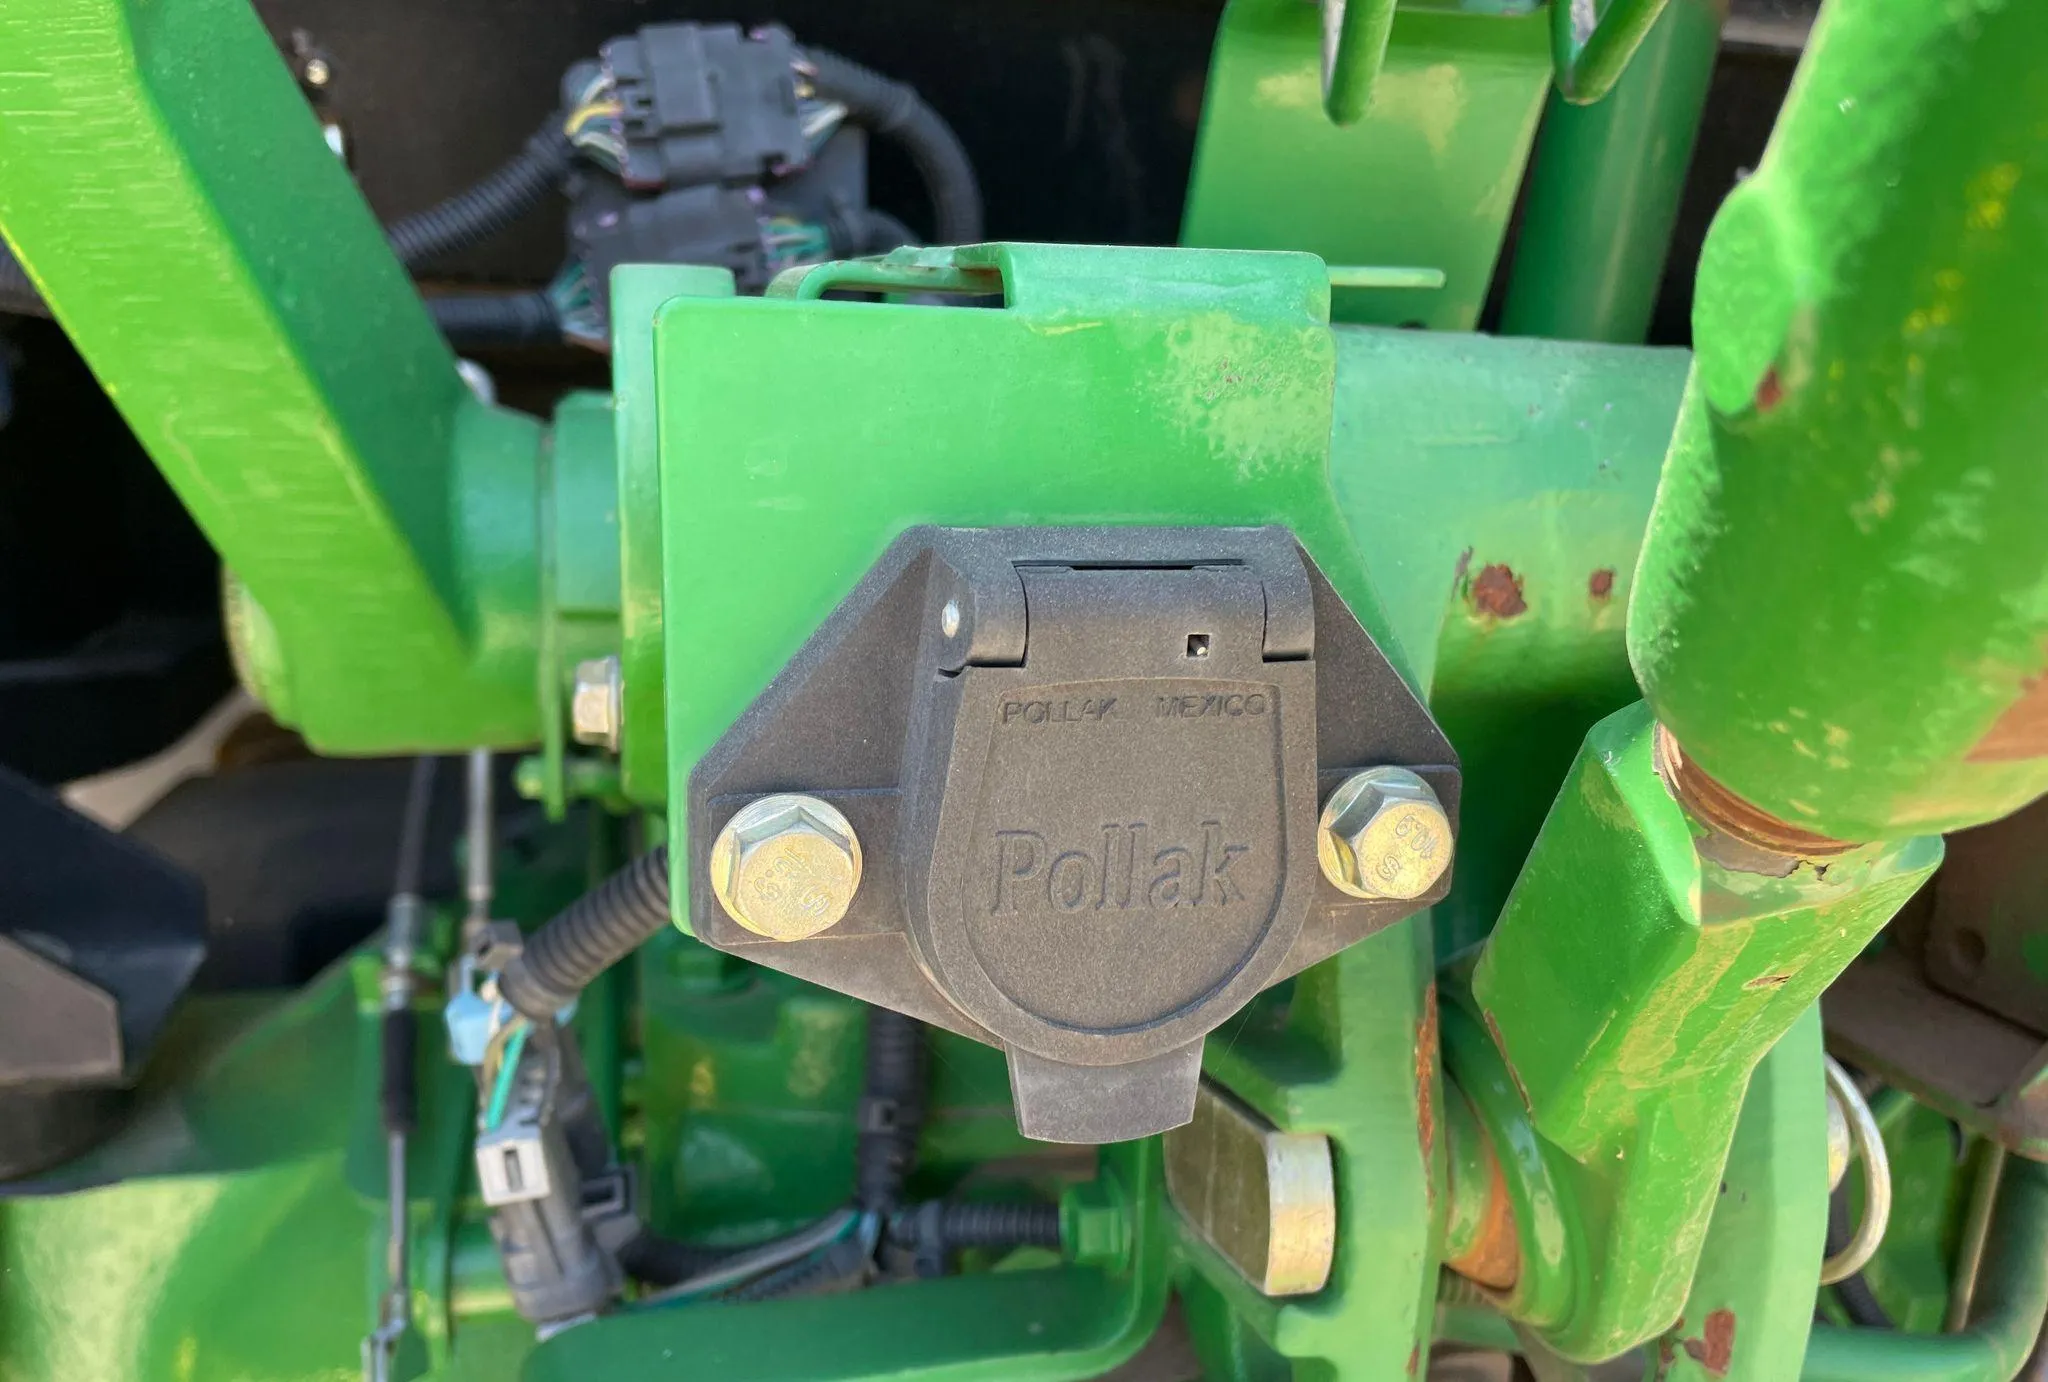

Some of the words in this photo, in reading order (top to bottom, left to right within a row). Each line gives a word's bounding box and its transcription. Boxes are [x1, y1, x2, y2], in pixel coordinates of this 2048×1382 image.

[1002, 699, 1120, 724] POLLAK
[1157, 693, 1267, 718] MEXICO
[991, 820, 1249, 914] Pollak
